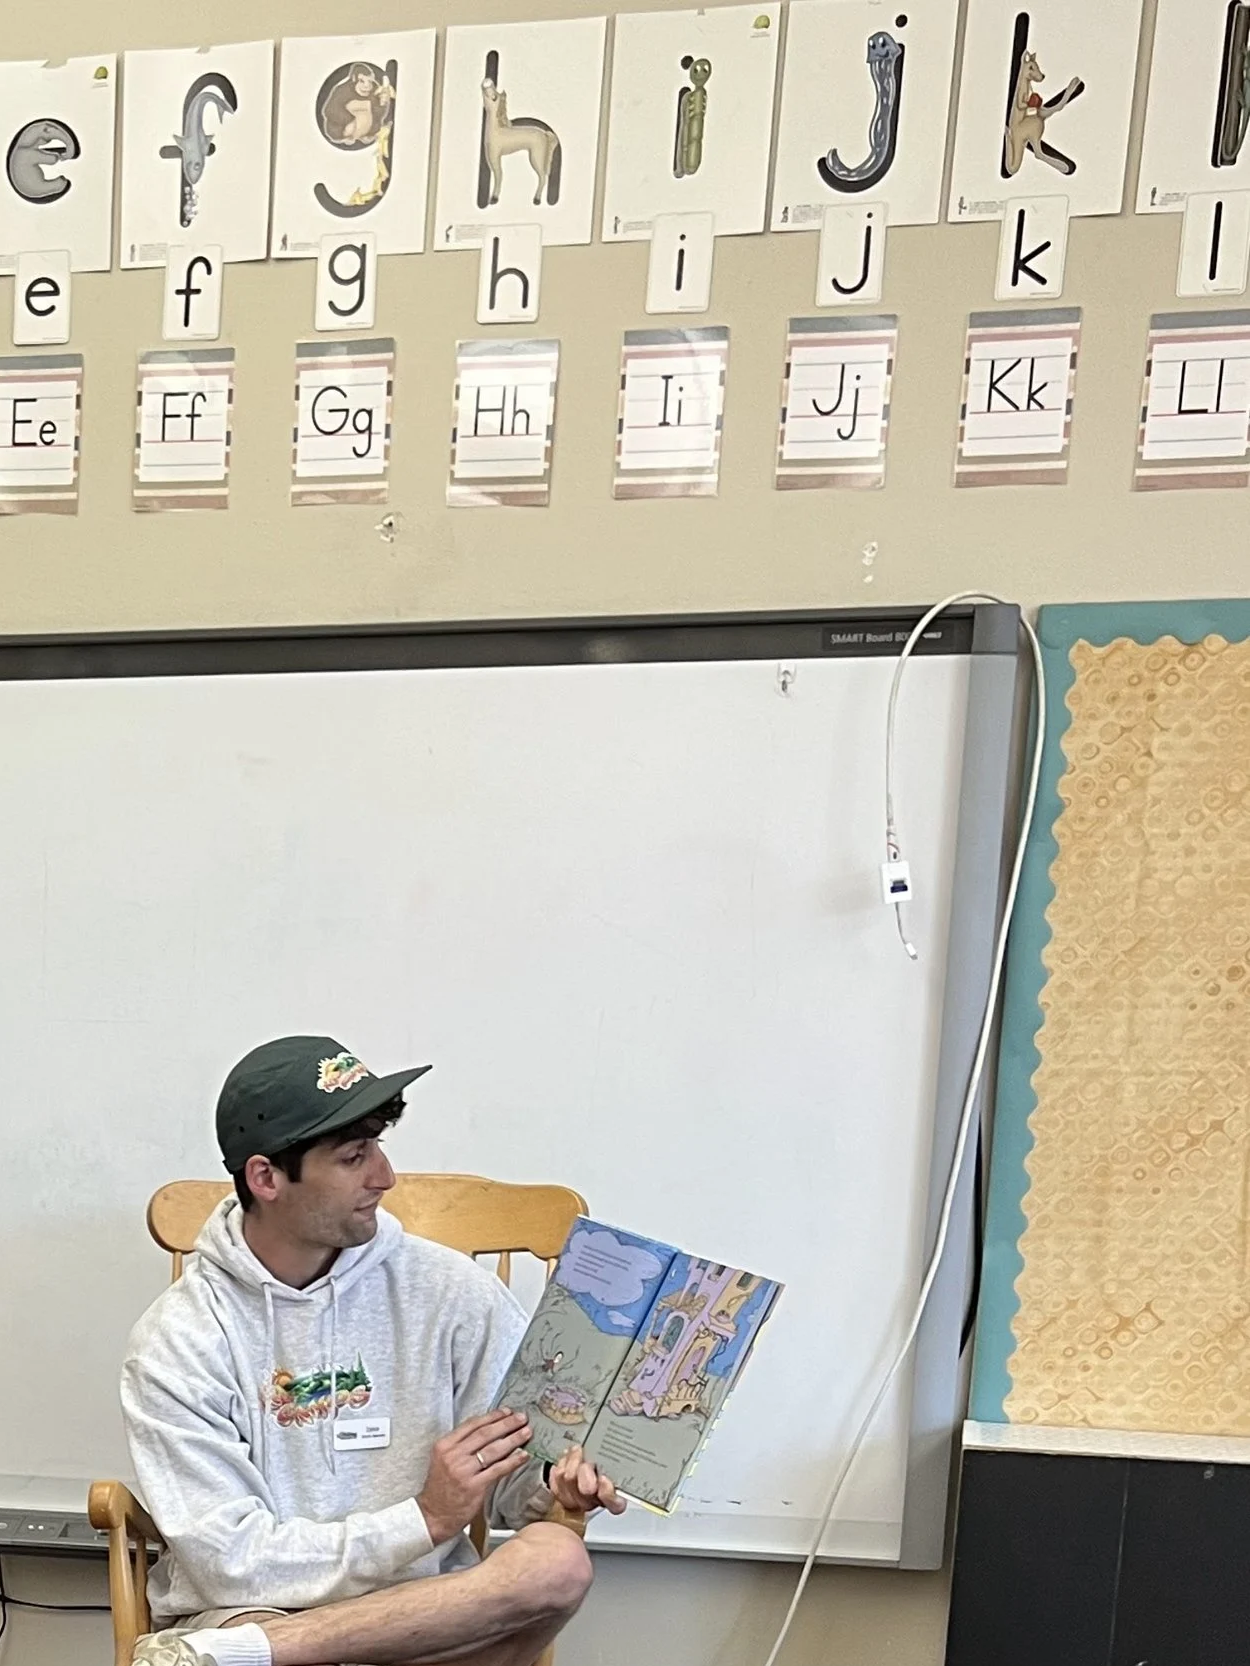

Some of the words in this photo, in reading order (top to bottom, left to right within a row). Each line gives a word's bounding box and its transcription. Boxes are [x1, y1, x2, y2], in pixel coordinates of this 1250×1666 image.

[489, 236, 529, 310] h
[675, 234, 686, 291] i
[831, 212, 873, 295] j
[1011, 208, 1052, 287] k
[1208, 201, 1223, 281] l
[25, 276, 60, 317] e
[175, 255, 212, 328] f
[328, 243, 367, 317] g
[161, 392, 207, 442] Ff
[473, 386, 530, 437] Hh
[658, 375, 684, 427] Ii
[812, 363, 861, 441] Jj
[986, 357, 1049, 413] Kk
[1176, 358, 1225, 415] Ll
[12, 398, 57, 447] Ee
[311, 385, 374, 458] Gg
